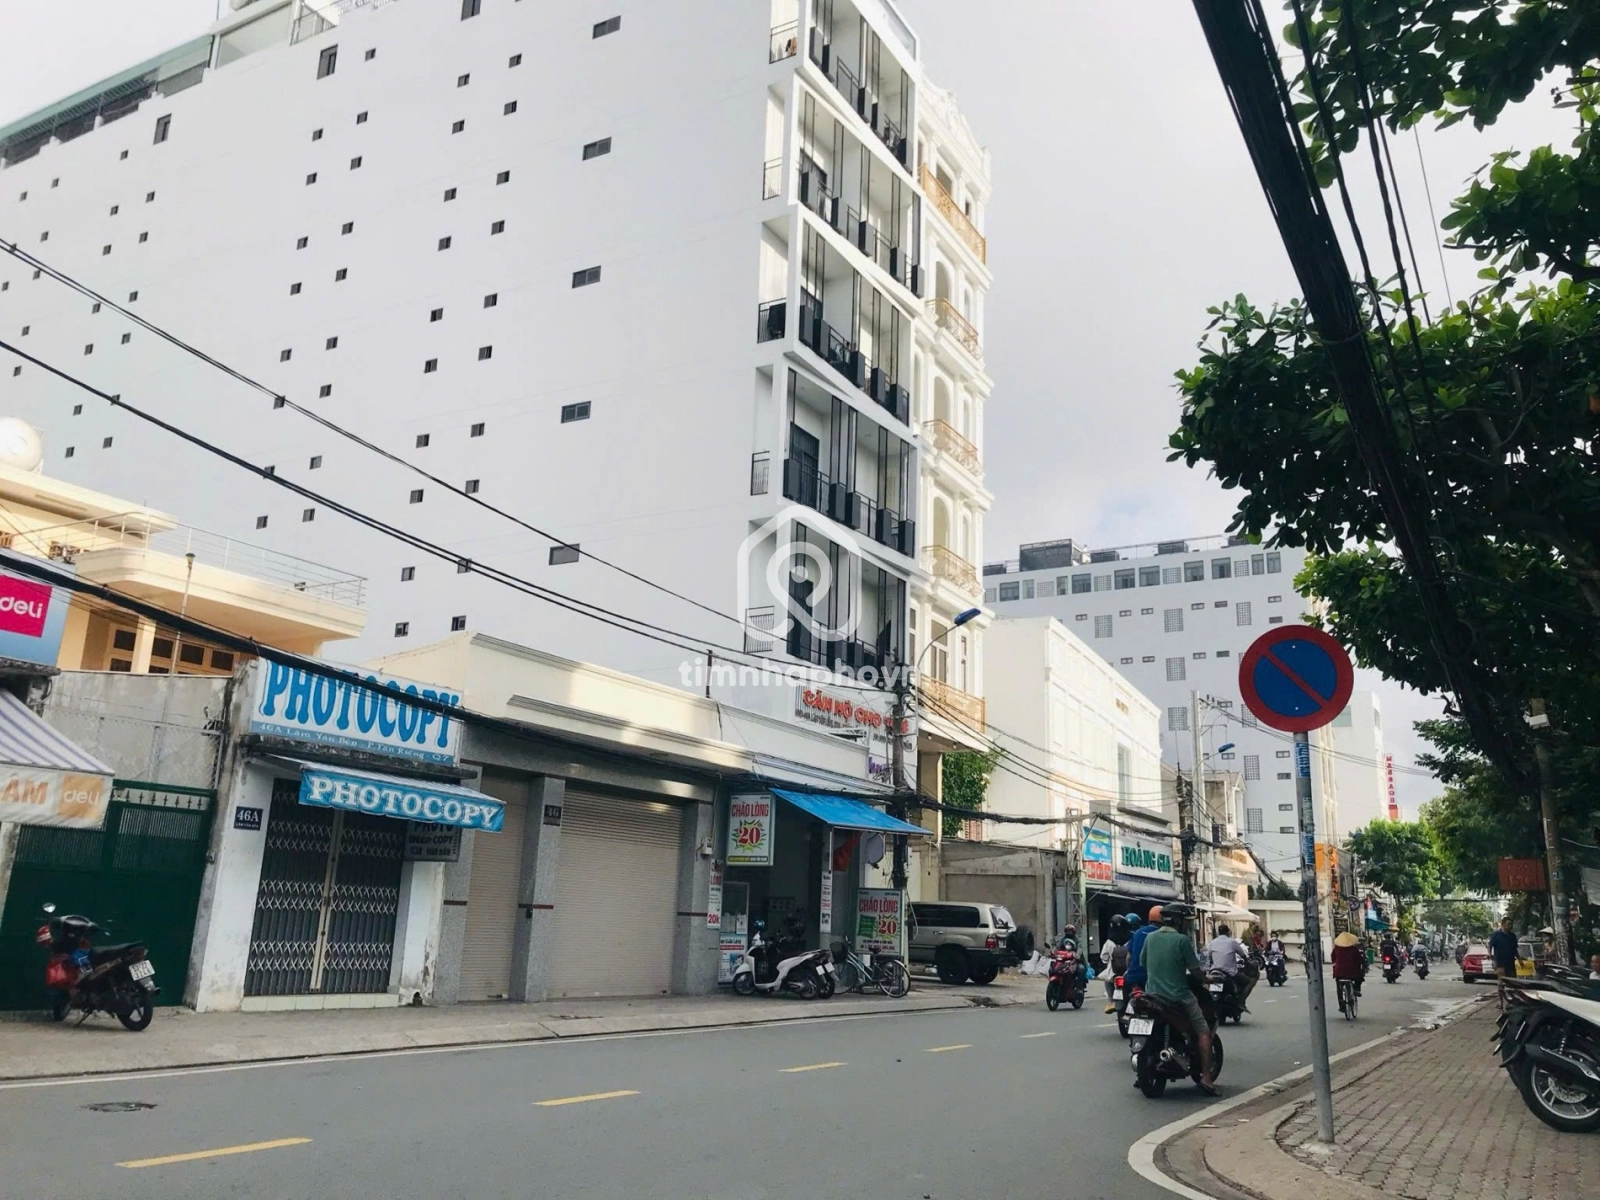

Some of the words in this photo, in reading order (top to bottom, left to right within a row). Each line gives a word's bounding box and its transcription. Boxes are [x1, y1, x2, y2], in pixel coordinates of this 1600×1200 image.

[0, 596, 42, 618] deli
[262, 660, 459, 748] PHOTOCOPY
[63, 789, 99, 804] deli
[309, 776, 499, 828] PHOTOCOPY
[237, 810, 259, 822] 46A
[737, 826, 761, 846] 20
[877, 920, 897, 935] 20
